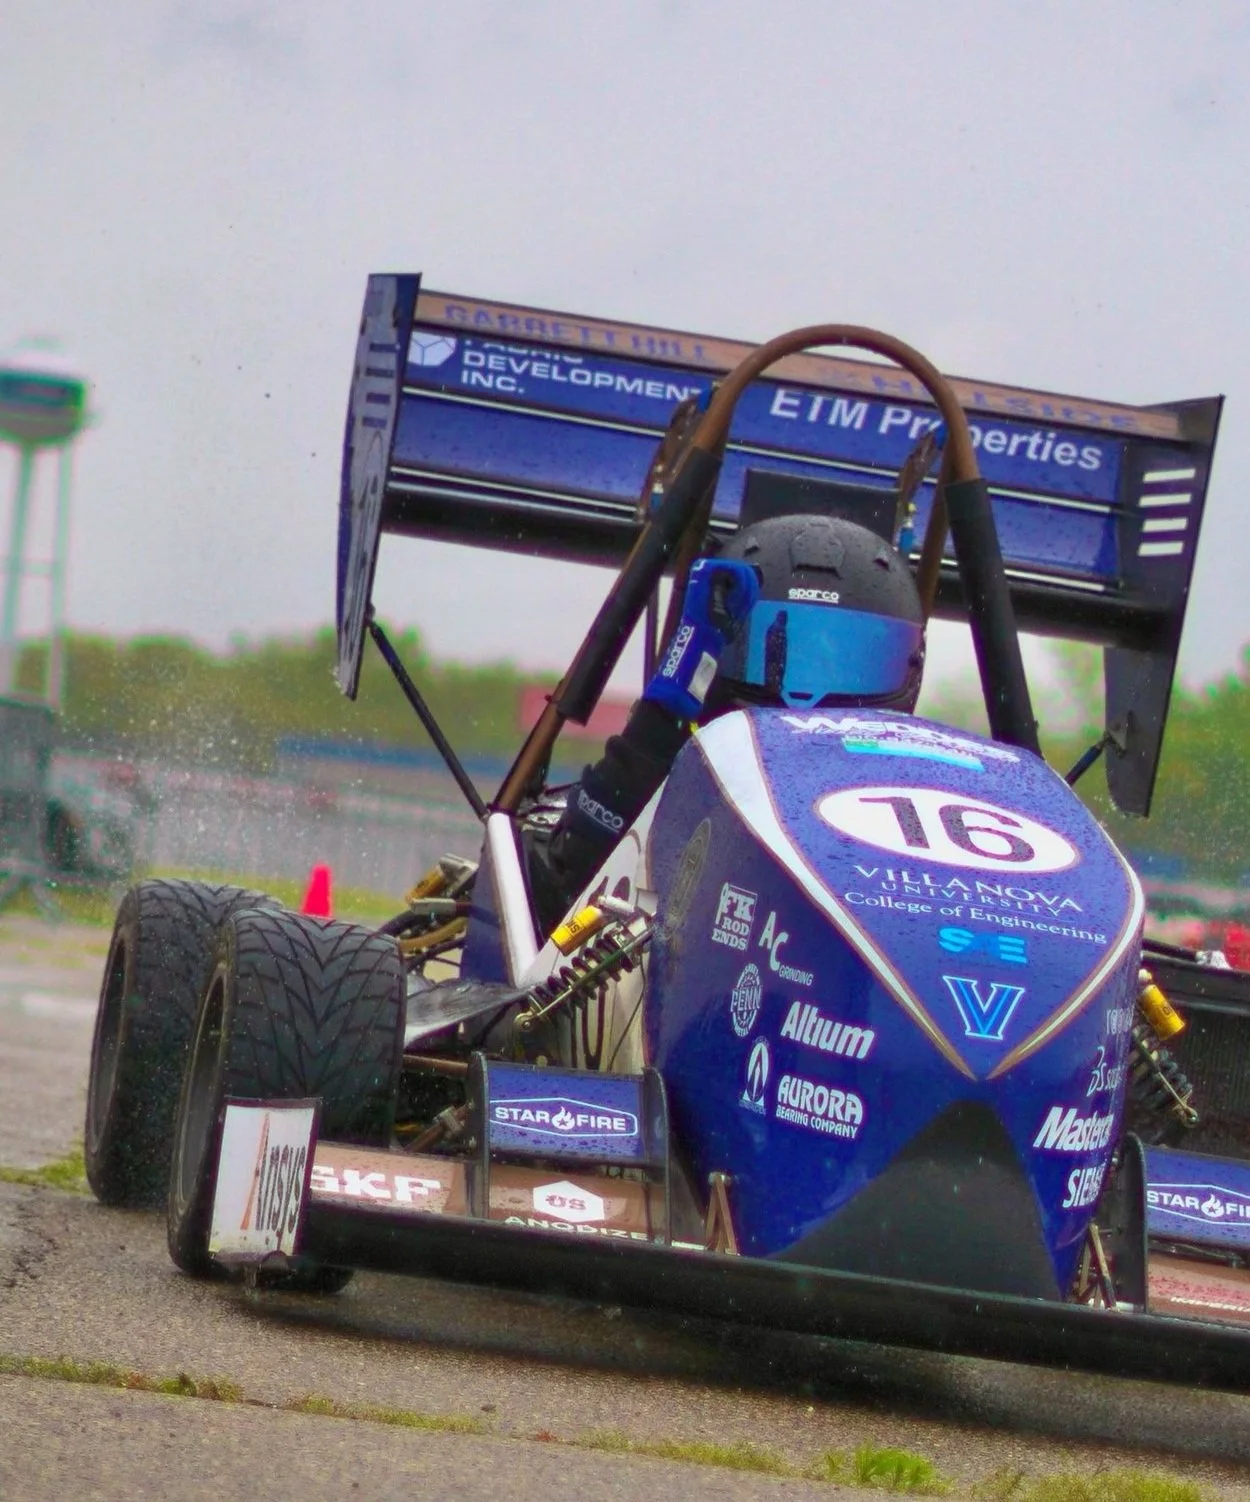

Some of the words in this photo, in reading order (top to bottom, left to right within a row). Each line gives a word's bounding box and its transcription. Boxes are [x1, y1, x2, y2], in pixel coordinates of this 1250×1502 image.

[461, 369, 525, 394] INC.
[878, 406, 1103, 473] Prerties
[788, 587, 840, 603] sparco
[662, 625, 695, 678] sparco
[857, 795, 1036, 863] 16
[852, 865, 1084, 912] VILLANOVA
[881, 881, 1061, 917] UNIVERSITY
[721, 916, 750, 935] ROD
[844, 892, 932, 914] College
[940, 905, 963, 918] of
[969, 907, 1108, 944] Engineering
[711, 927, 748, 951] ENDS
[778, 964, 814, 987] GRINDING
[730, 984, 762, 1013] PENN
[780, 1000, 876, 1060] Altium
[777, 1074, 864, 1125] AURORA
[494, 1106, 550, 1124] STAR
[576, 1114, 626, 1131] FIRE
[775, 1104, 809, 1127] BEARING
[810, 1115, 858, 1139] COMPANY
[310, 1165, 441, 1204] SKF
[1147, 1190, 1200, 1210] STAR
[504, 1215, 648, 1241] ANODIZE
